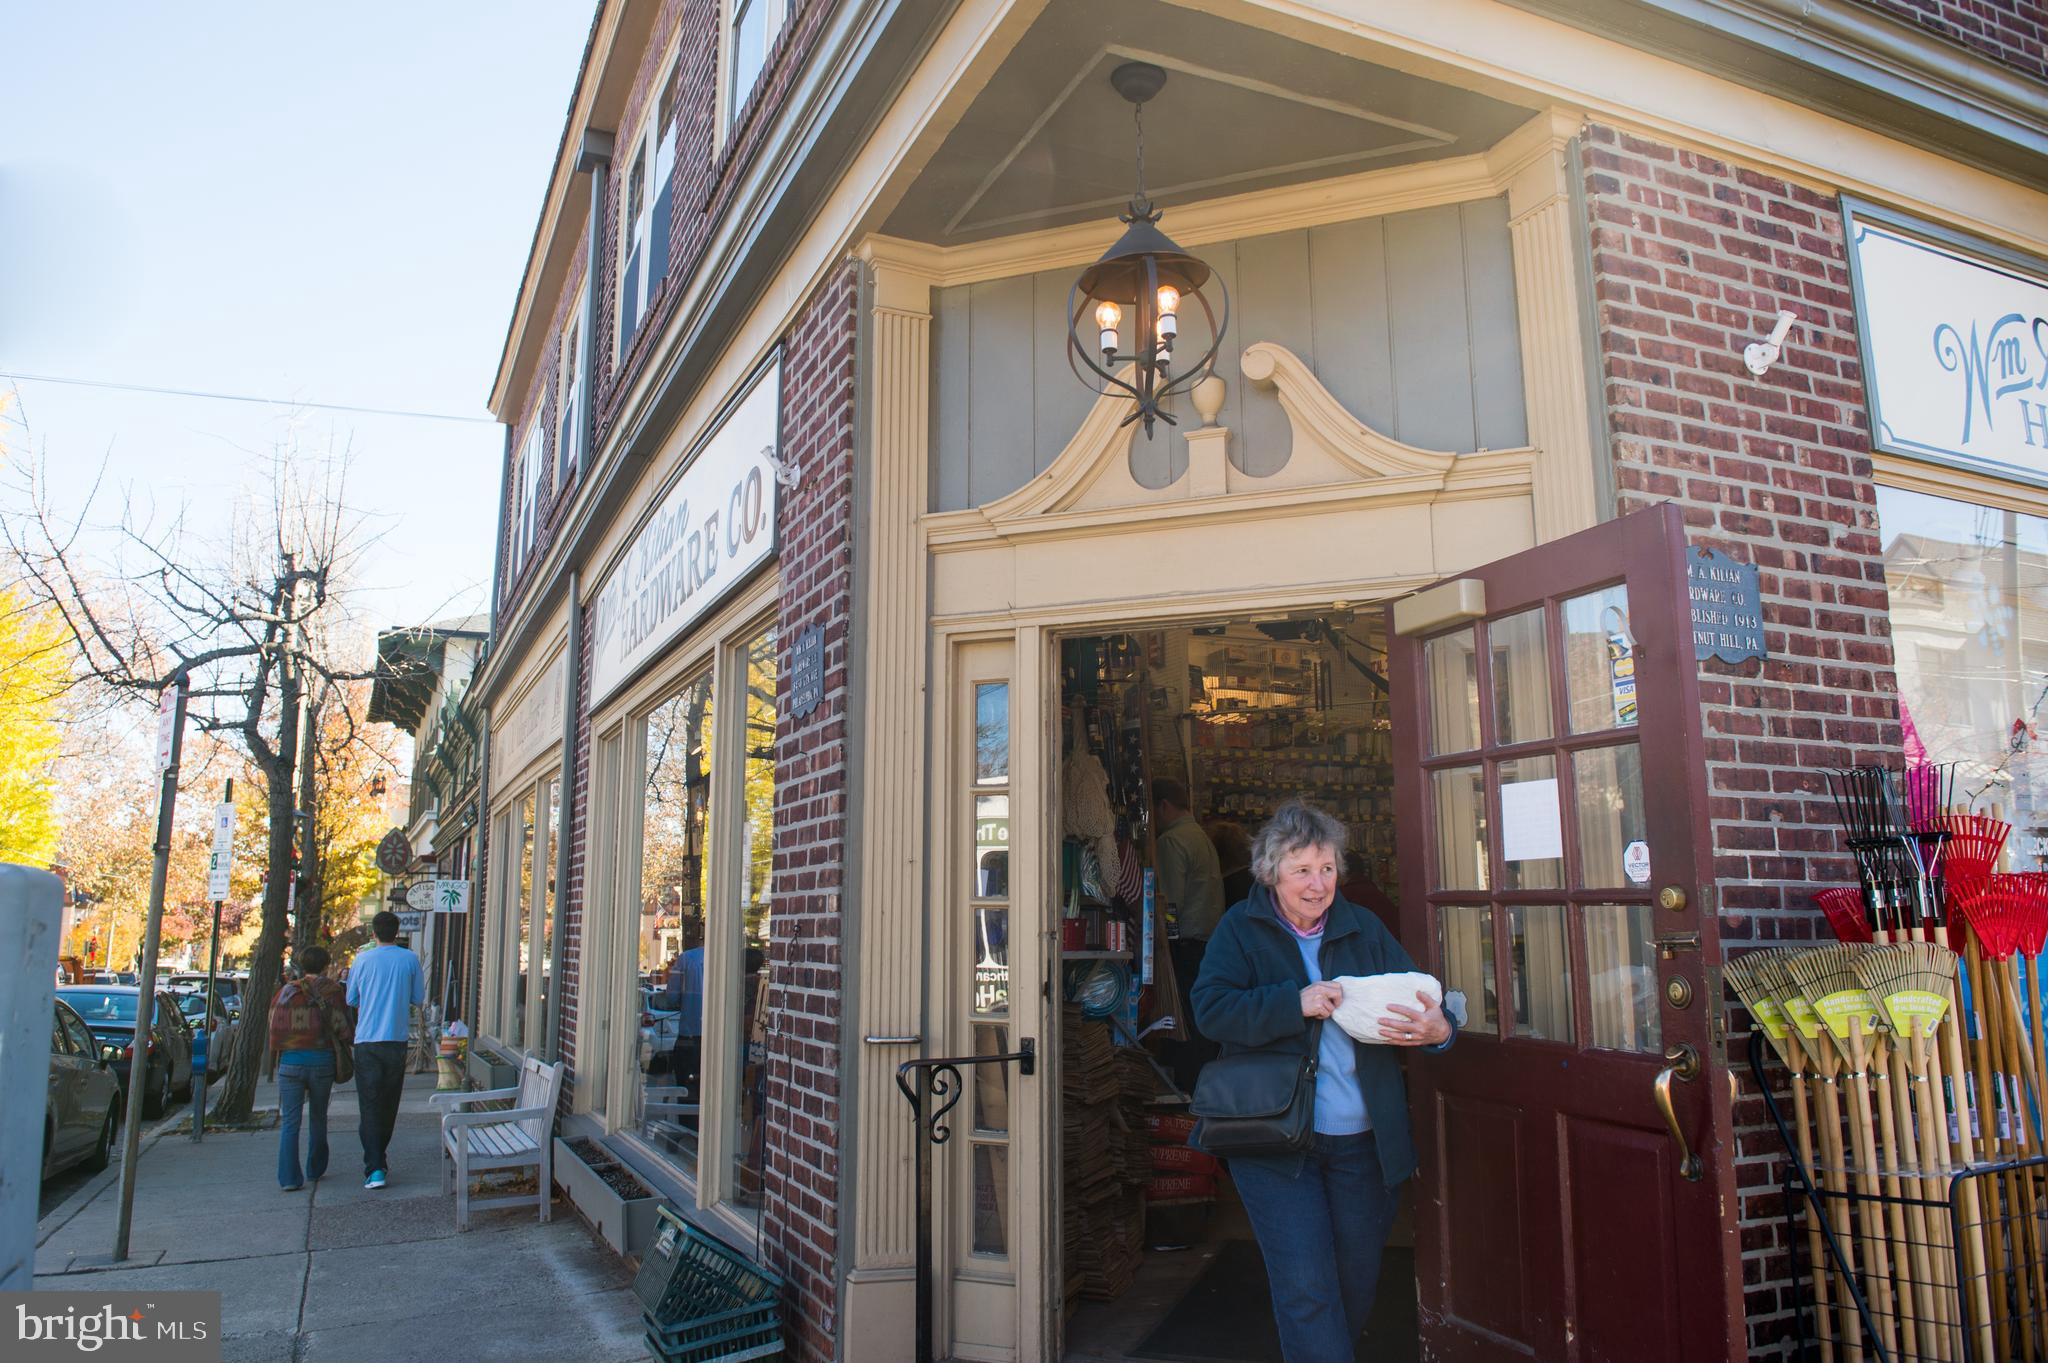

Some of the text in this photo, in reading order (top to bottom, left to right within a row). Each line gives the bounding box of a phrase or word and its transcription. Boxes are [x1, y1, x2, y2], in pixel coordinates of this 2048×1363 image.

[619, 509, 719, 665] HARDWARE
[726, 465, 767, 559] CO.
[1710, 567, 1740, 584] KILIAN
[1689, 586, 1726, 604] RDWARE
[1690, 608, 1757, 629] BLISHED 1913
[1693, 631, 1715, 646] TNUT
[1618, 685, 1634, 695] VISA
[409, 884, 434, 897] Artisa
[437, 880, 469, 890] MANGO
[399, 915, 420, 926] ots
[1164, 1118, 1195, 1130] SUPRE
